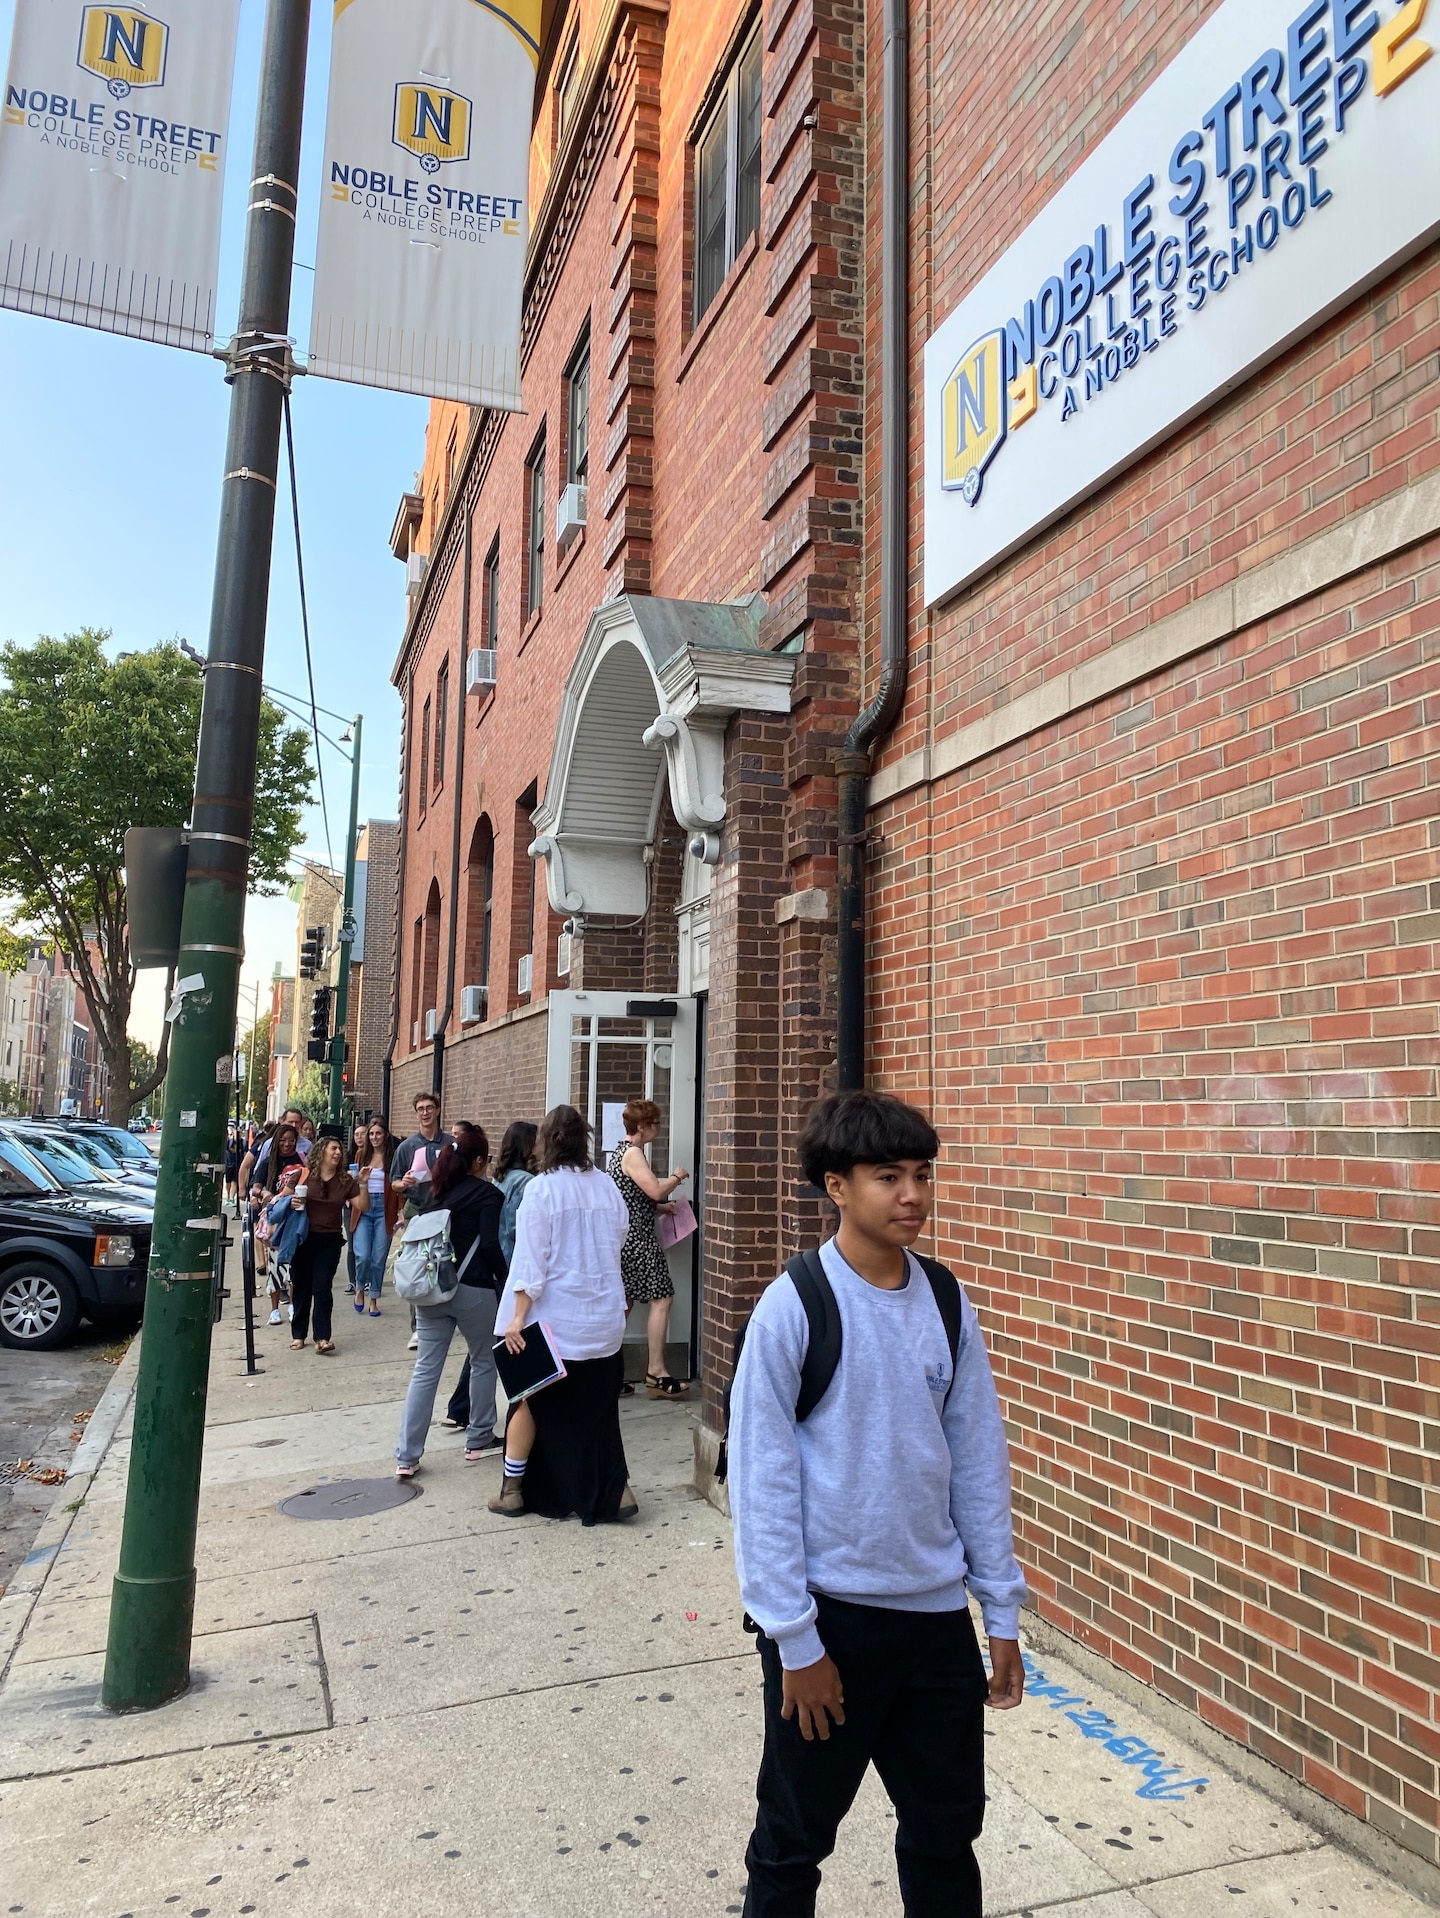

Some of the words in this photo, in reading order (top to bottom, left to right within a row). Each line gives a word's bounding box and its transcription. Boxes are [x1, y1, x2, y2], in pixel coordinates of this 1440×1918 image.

[99, 12, 149, 70] N
[6, 85, 105, 125] NOBLE
[113, 110, 221, 153] STREET
[27, 114, 131, 149] COLLEGE
[140, 140, 197, 164] PREP
[411, 90, 454, 145] N
[40, 133, 50, 144] A
[56, 136, 110, 158] NOBLE
[116, 151, 179, 175] SCHOOL
[331, 161, 418, 201] NOBLE
[426, 184, 522, 219] STREET
[351, 190, 442, 222] COLLEGE
[450, 212, 501, 232] PREP
[1006, 174, 1156, 381] NOBLE
[1168, 0, 1402, 216] STREE
[362, 209, 372, 221] A
[377, 212, 424, 231] NOBLE
[430, 223, 486, 243] SCHOOL
[1038, 202, 1210, 399] COLLEGE
[1227, 57, 1368, 230] PREP
[1060, 385, 1079, 422] A
[1084, 292, 1178, 400] NOBLE
[1186, 166, 1333, 310] SCHOOL
[954, 346, 988, 459] N
